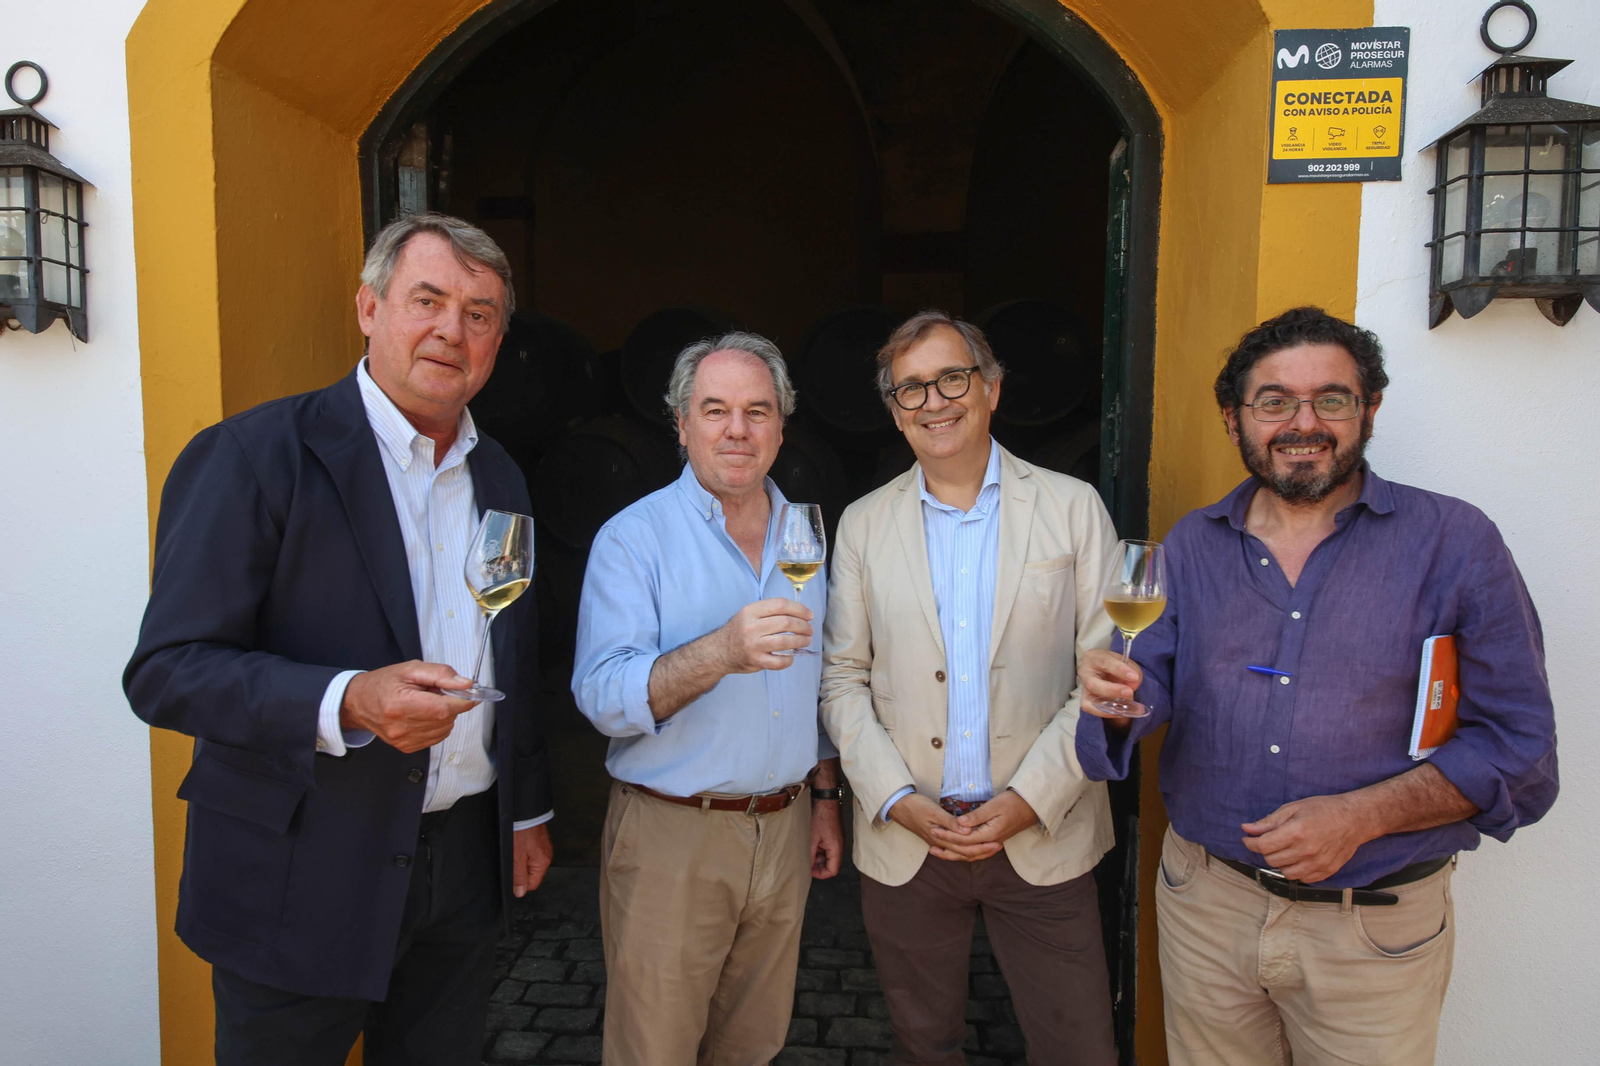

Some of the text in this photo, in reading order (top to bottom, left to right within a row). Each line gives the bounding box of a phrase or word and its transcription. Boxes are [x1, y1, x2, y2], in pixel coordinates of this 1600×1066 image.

[1350, 50, 1404, 59] PROSEGUR
[1350, 60, 1392, 68] ALARMAS
[1284, 90, 1392, 105] CONECTADA
[1283, 108, 1306, 116] CON
[1309, 107, 1340, 116] AVISO
[1352, 104, 1392, 115] POLICÍA
[1308, 164, 1324, 172] 902
[1343, 163, 1360, 171] 999
